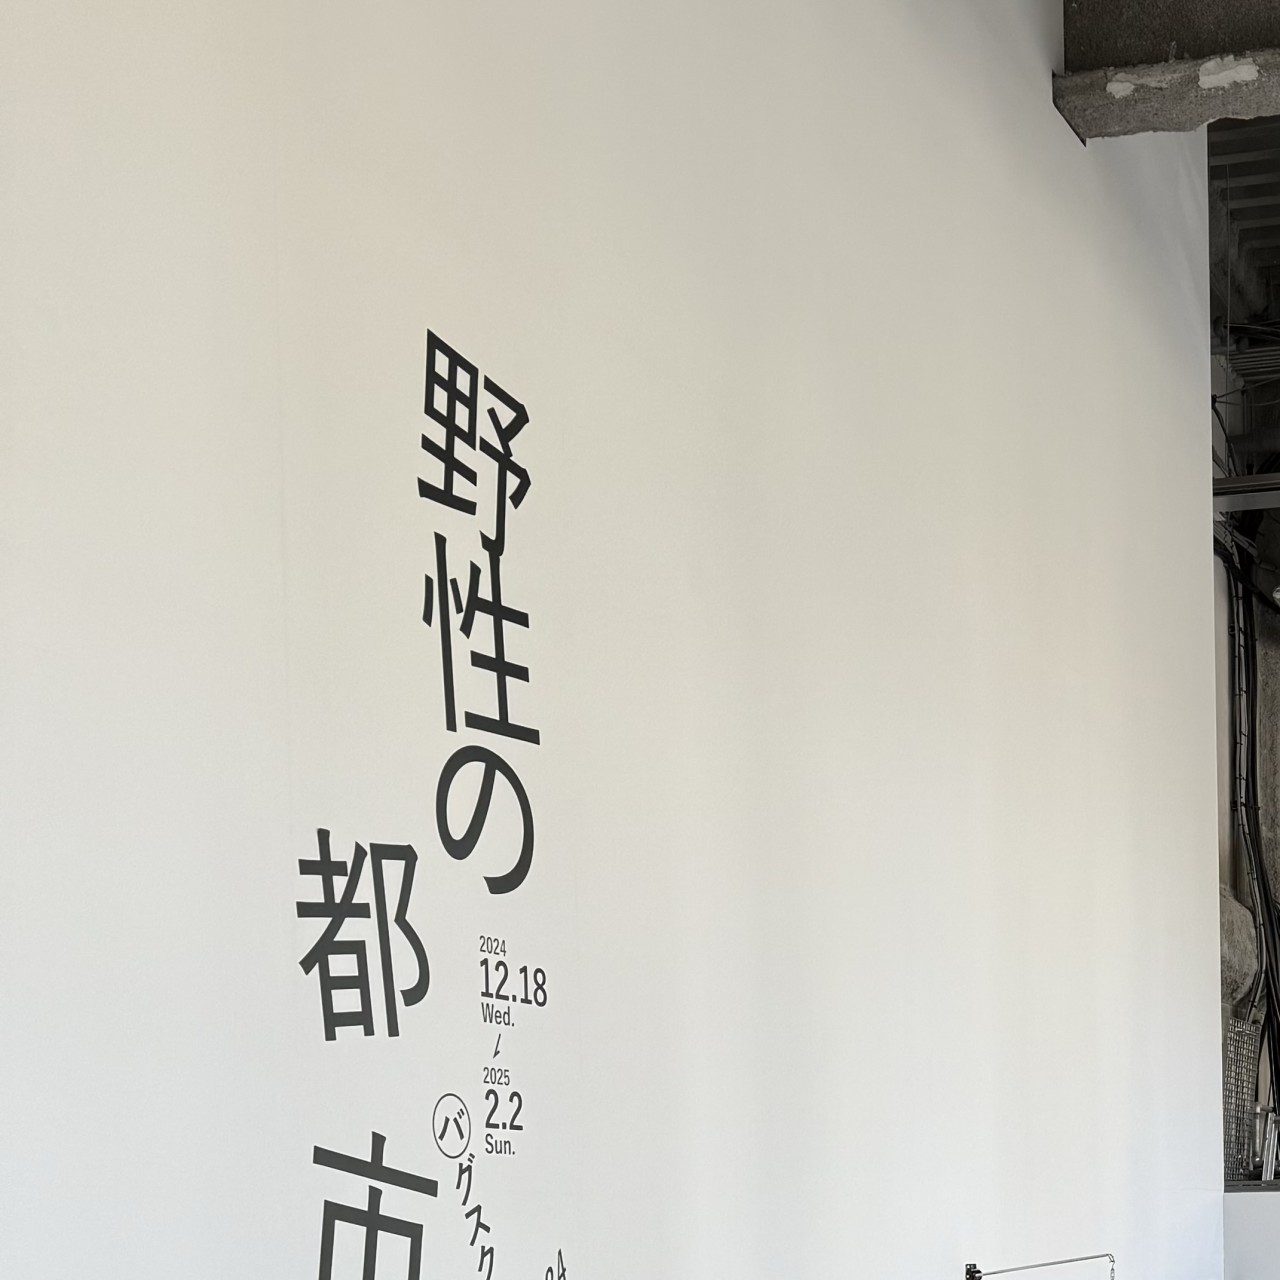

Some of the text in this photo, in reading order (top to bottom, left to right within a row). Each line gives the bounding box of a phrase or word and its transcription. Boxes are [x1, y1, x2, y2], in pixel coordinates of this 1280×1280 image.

[479, 935, 507, 957] 2024
[480, 957, 548, 1007] 12.18
[481, 1002, 515, 1027] Wed.
[483, 1067, 511, 1087] 2025
[484, 1089, 524, 1131] 2.2
[484, 1133, 516, 1156] Sun.
